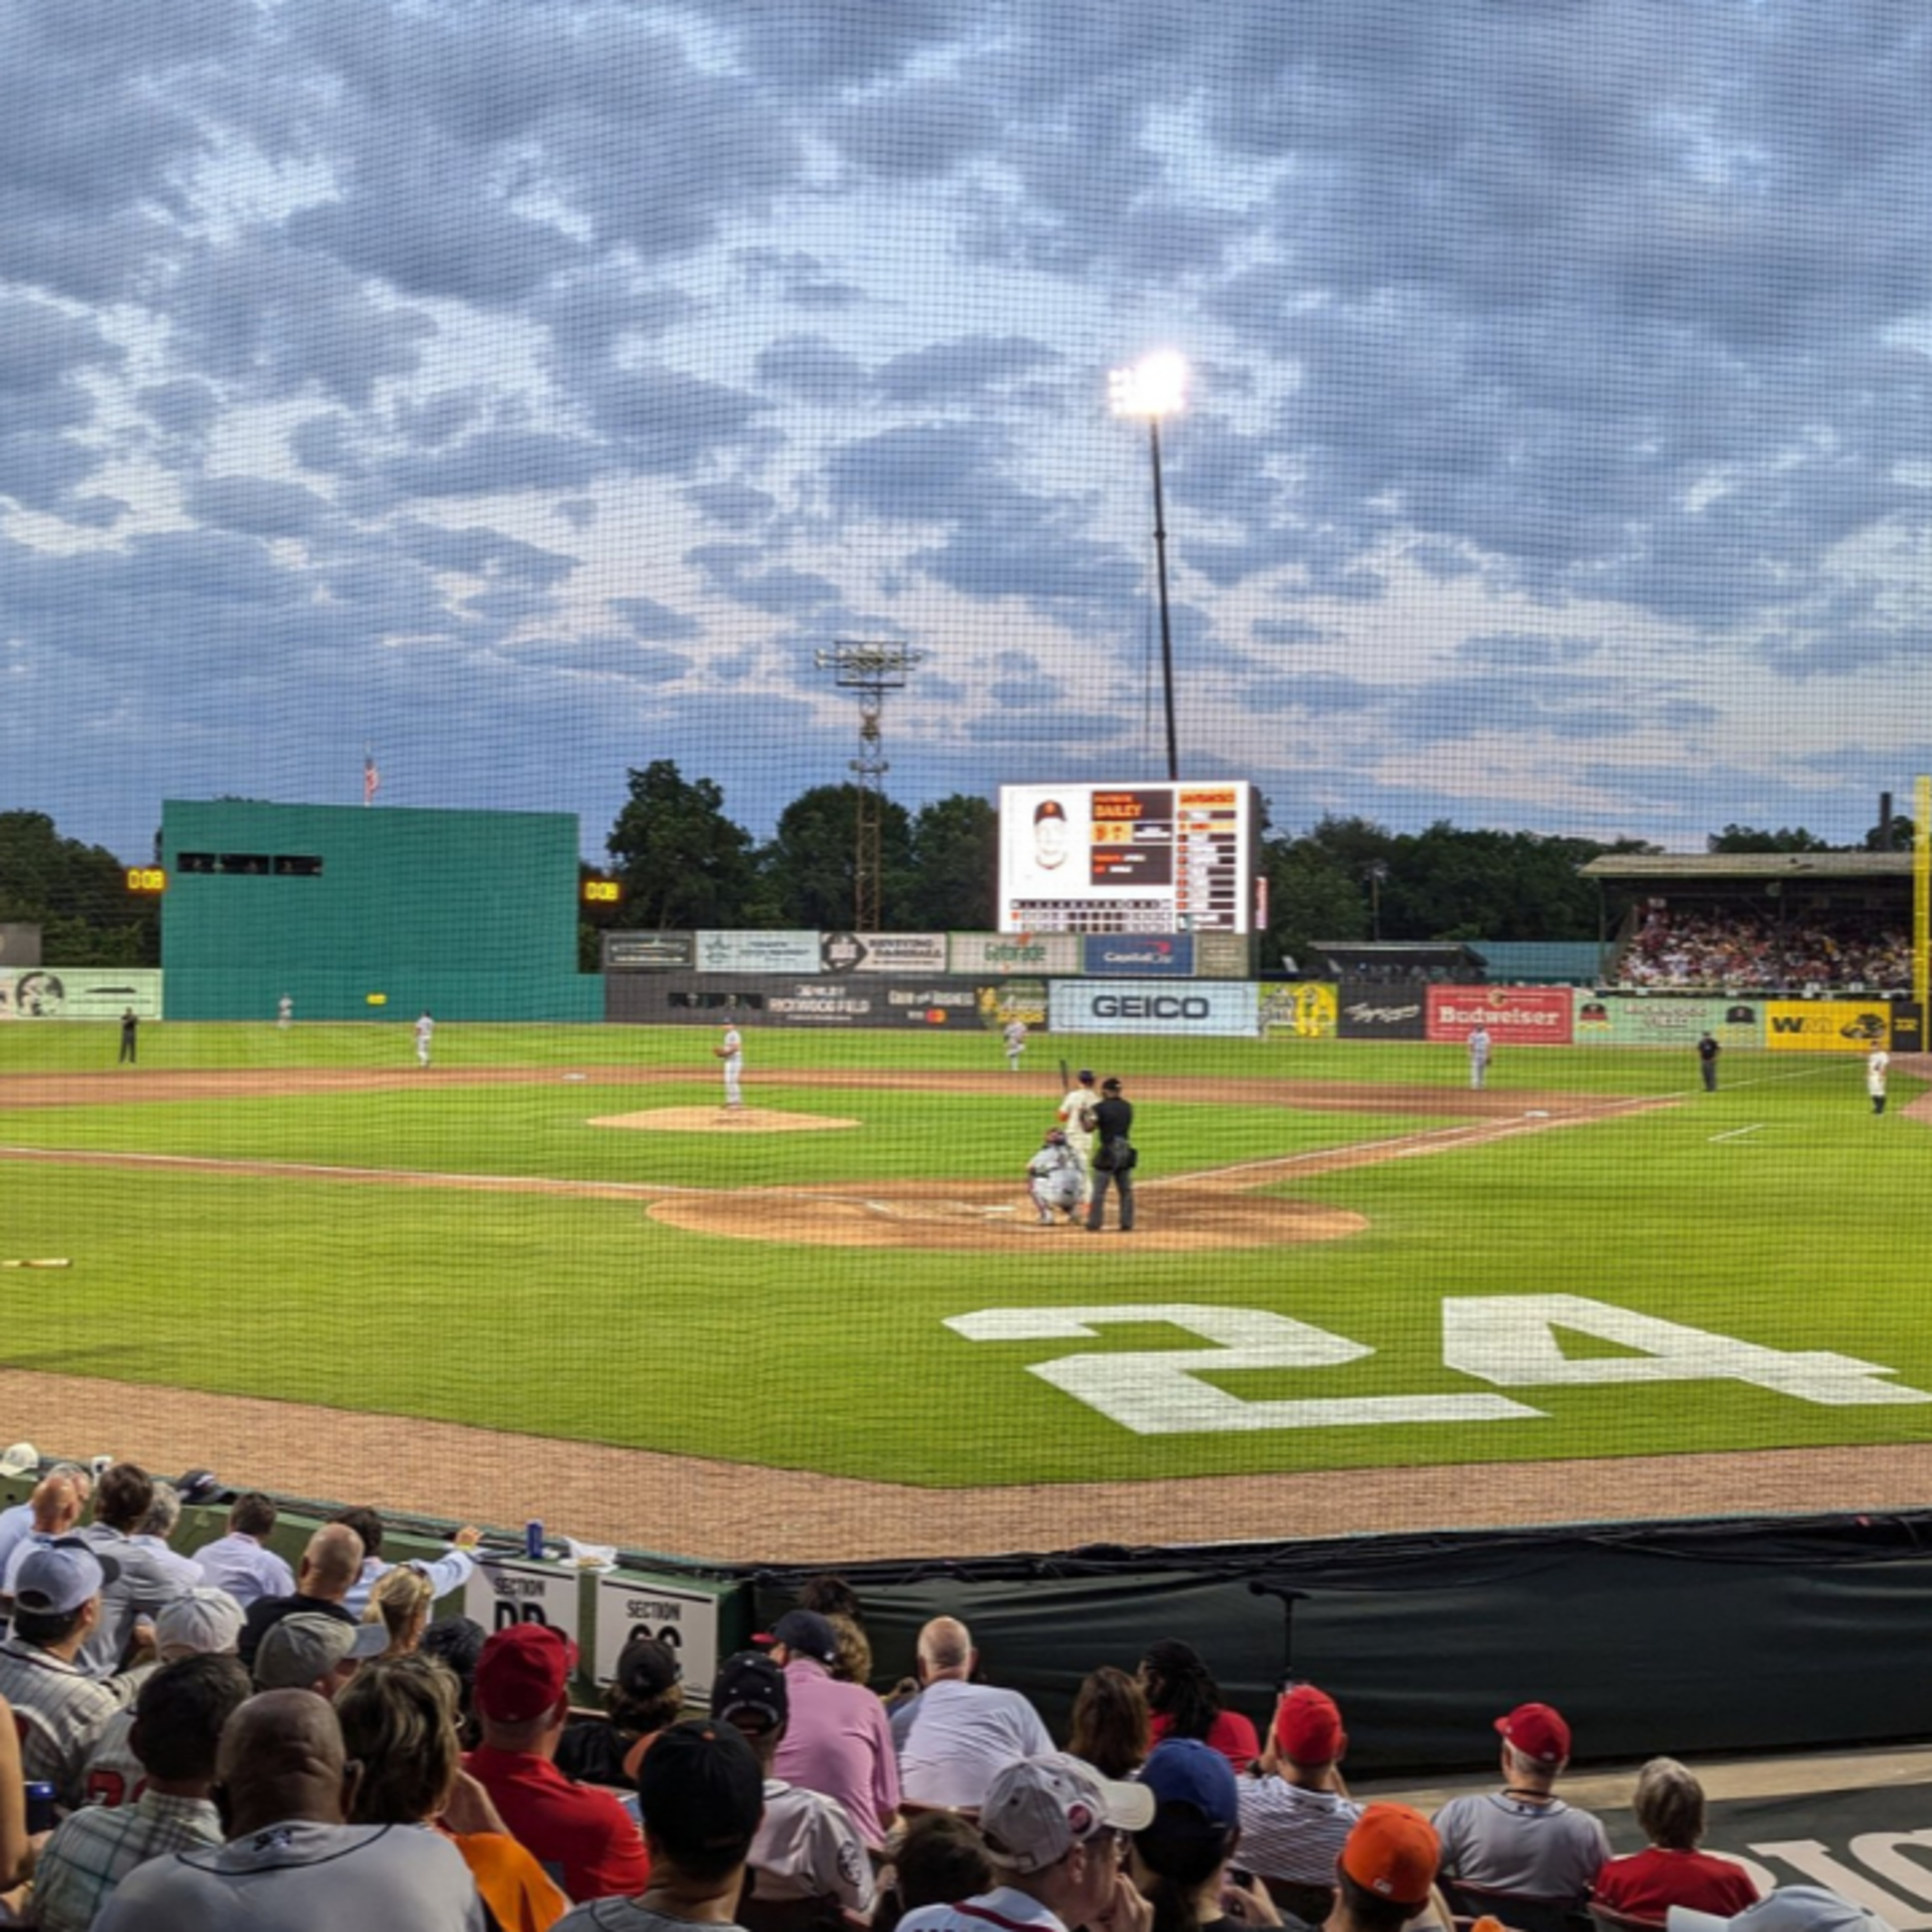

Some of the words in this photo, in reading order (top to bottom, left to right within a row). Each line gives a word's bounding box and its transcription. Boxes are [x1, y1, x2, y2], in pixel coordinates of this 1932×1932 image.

[1093, 996, 1209, 1019] GEICO
[1439, 1005, 1560, 1025] Budweiser
[1772, 1016, 1834, 1034] WM
[941, 1293, 1932, 1435] 24
[494, 1577, 545, 1596] SECTION
[627, 1599, 681, 1621] SECTION
